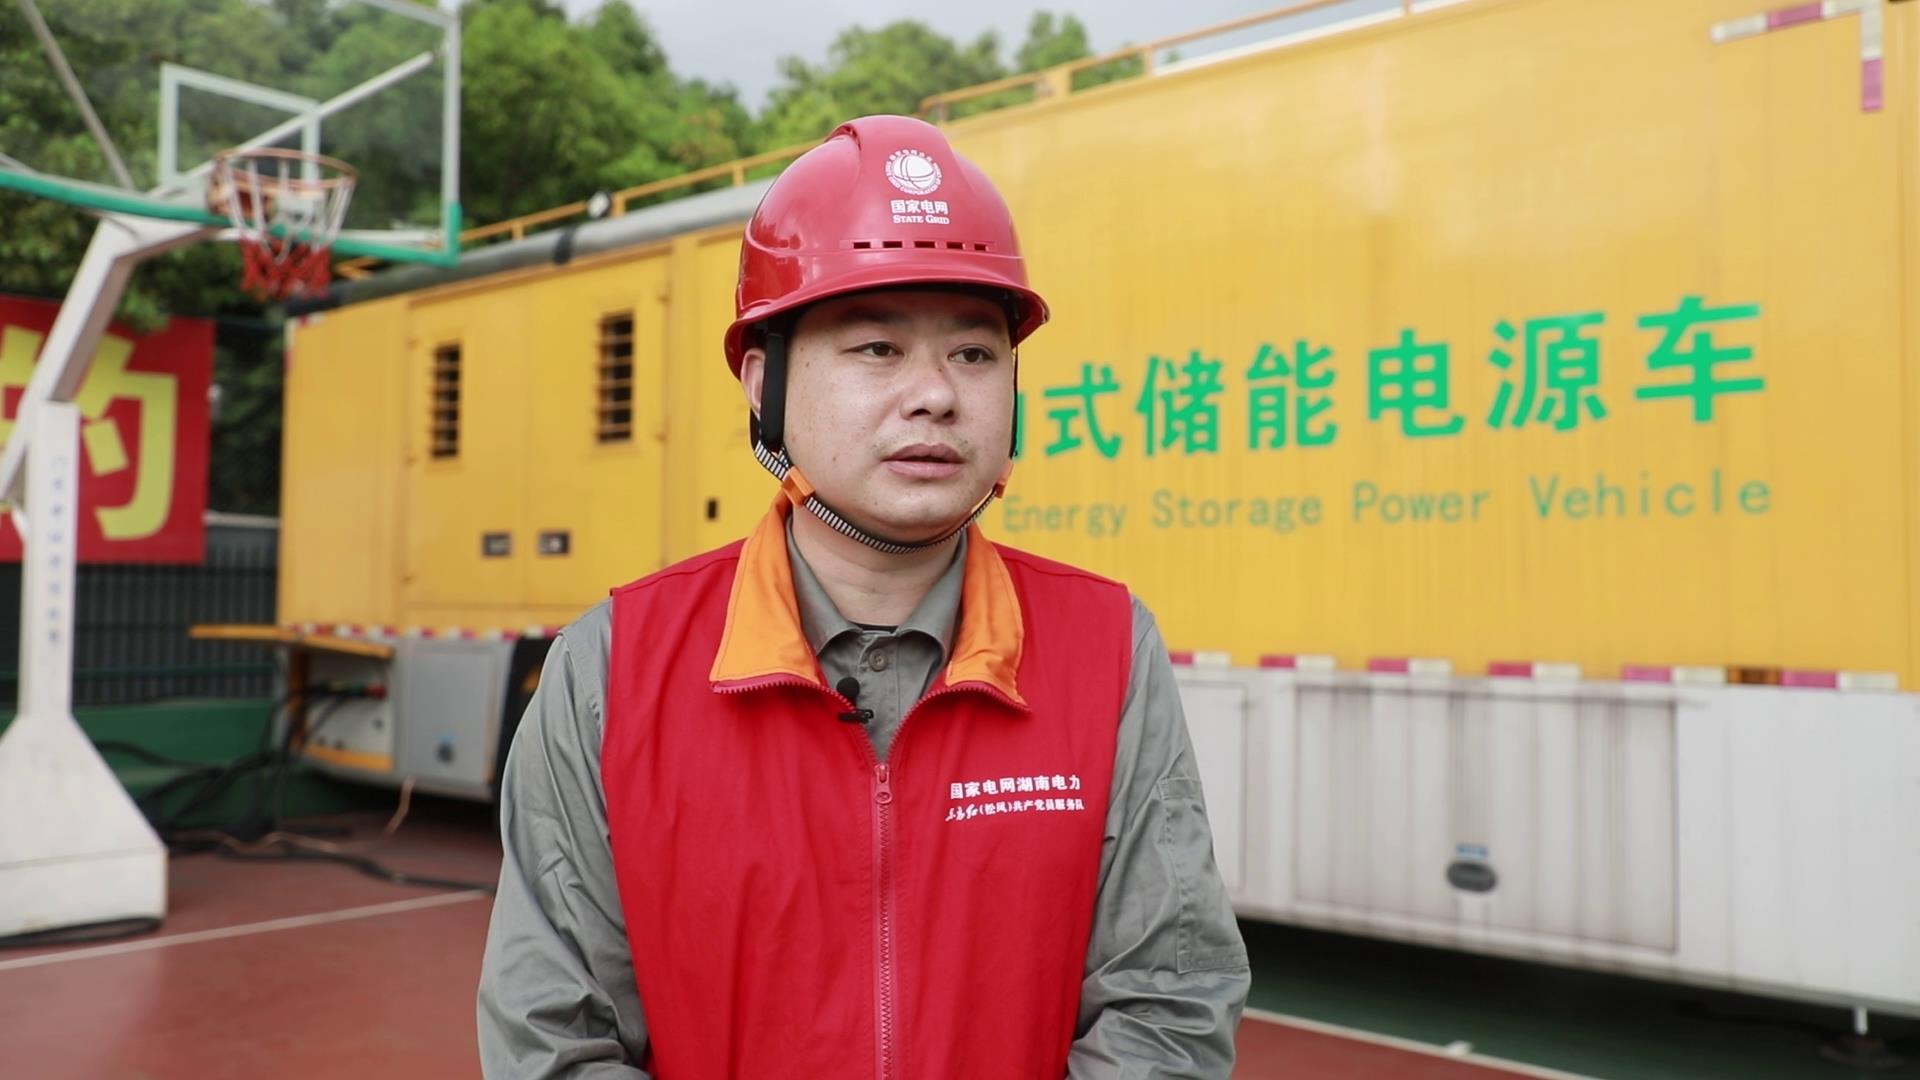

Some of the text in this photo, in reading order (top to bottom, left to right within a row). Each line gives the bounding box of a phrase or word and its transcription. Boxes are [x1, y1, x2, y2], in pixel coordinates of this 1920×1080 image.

[890, 200, 949, 215] 国家电网
[893, 215, 924, 224] STATE
[1014, 296, 1766, 461] 式储能电源车
[1003, 469, 1772, 538] Energy Storage Power Vehicle
[950, 774, 1082, 799] 国家电网湖南电力
